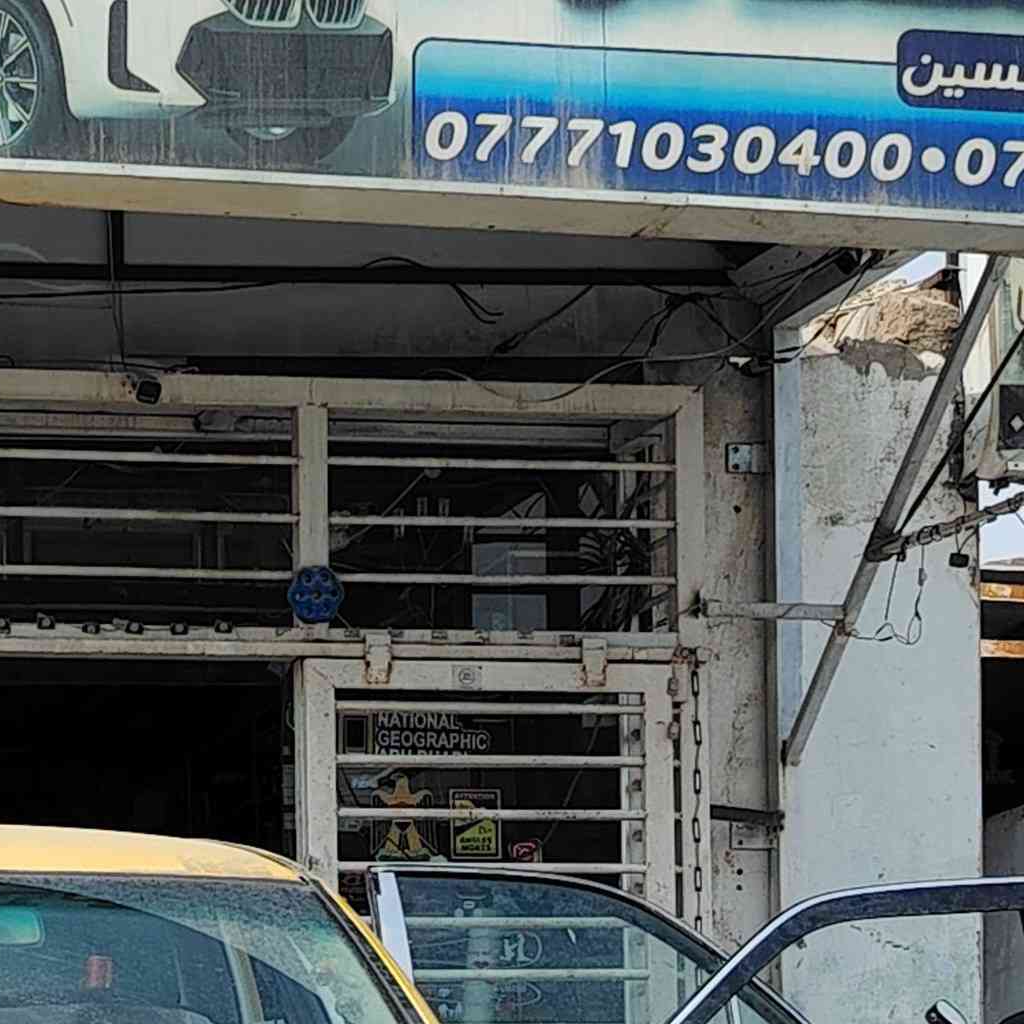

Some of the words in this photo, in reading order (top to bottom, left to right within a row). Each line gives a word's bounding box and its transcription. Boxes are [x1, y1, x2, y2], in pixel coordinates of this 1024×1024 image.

[425, 111, 913, 182] 07771030400
[378, 711, 460, 730] NATIONAL
[377, 730, 488, 750] GEOGRAPHIC
